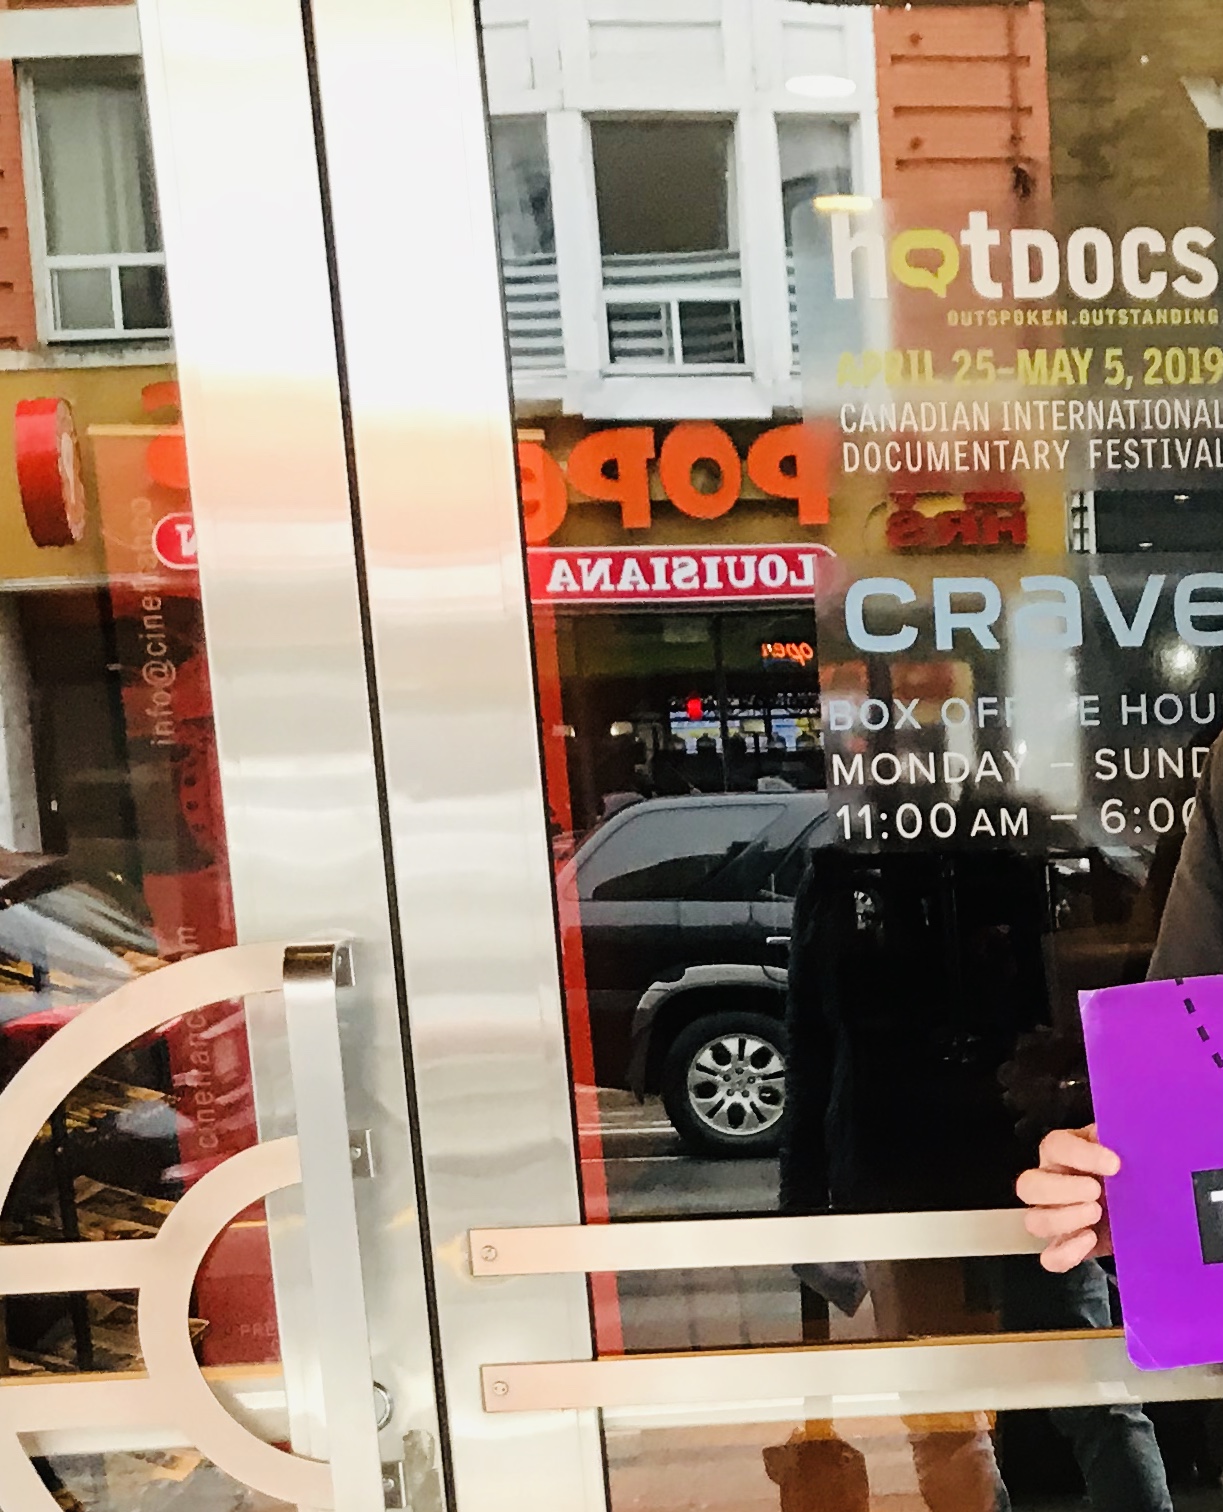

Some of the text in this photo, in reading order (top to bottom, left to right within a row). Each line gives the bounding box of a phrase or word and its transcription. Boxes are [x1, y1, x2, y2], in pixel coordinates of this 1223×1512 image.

[837, 349, 937, 388] APRIL
[1103, 347, 1134, 392] 5,
[840, 403, 991, 433] CANADIAN
[843, 440, 1070, 472] DOCUMENTARY
[829, 696, 922, 732] BOX
[831, 750, 1026, 787] MONDAY
[836, 801, 957, 842] 11:00
[970, 807, 1029, 838] AM
